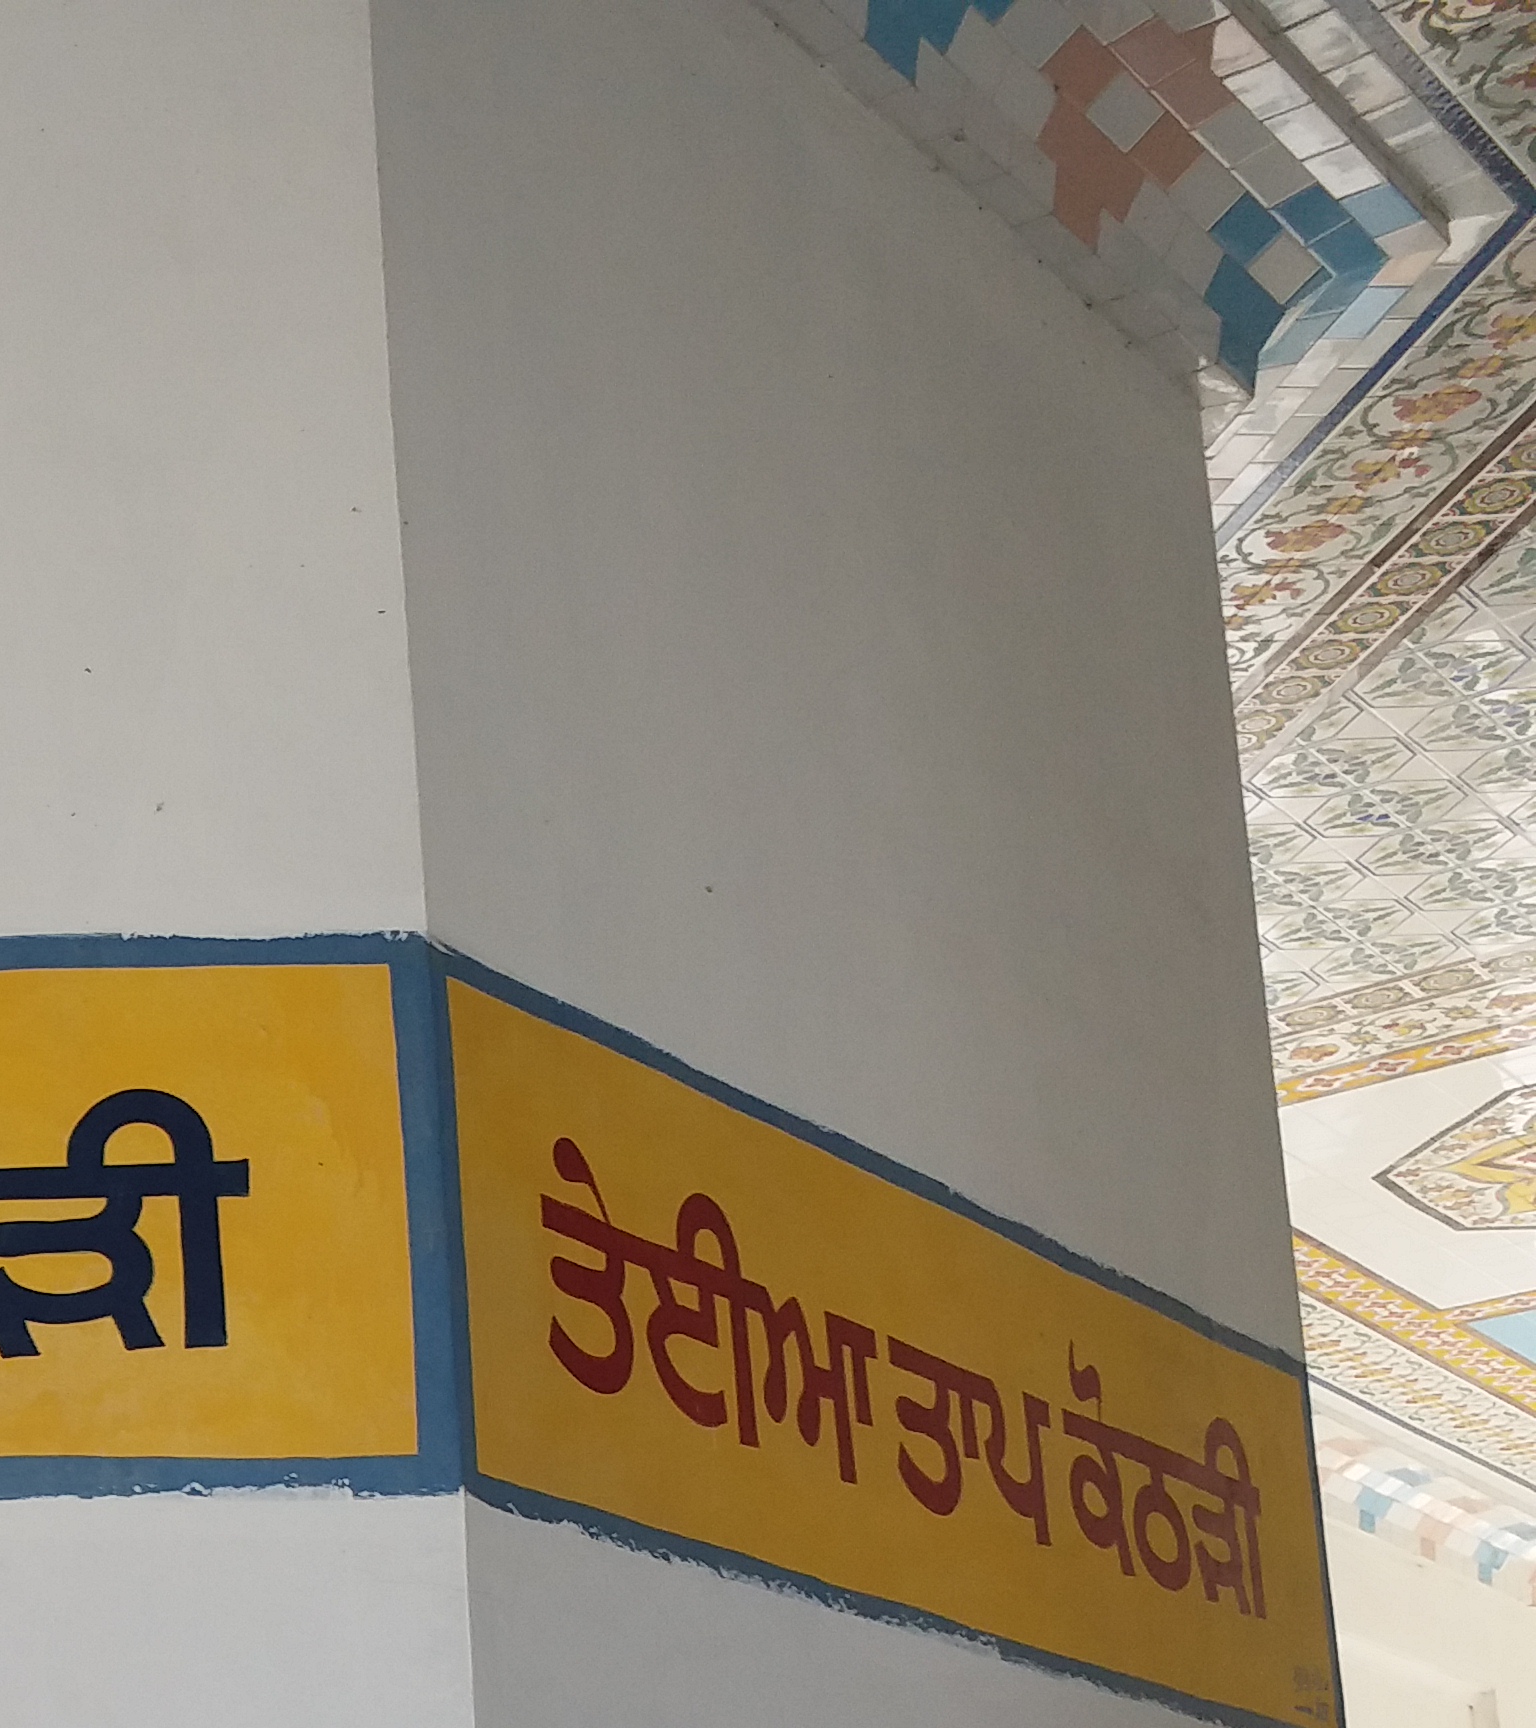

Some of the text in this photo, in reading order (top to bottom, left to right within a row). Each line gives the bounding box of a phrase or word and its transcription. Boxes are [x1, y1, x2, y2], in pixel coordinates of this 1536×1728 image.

[539, 1136, 1267, 1620] ਤੇਈਆ ਤਾਪ ਕੋਠੜੀ
